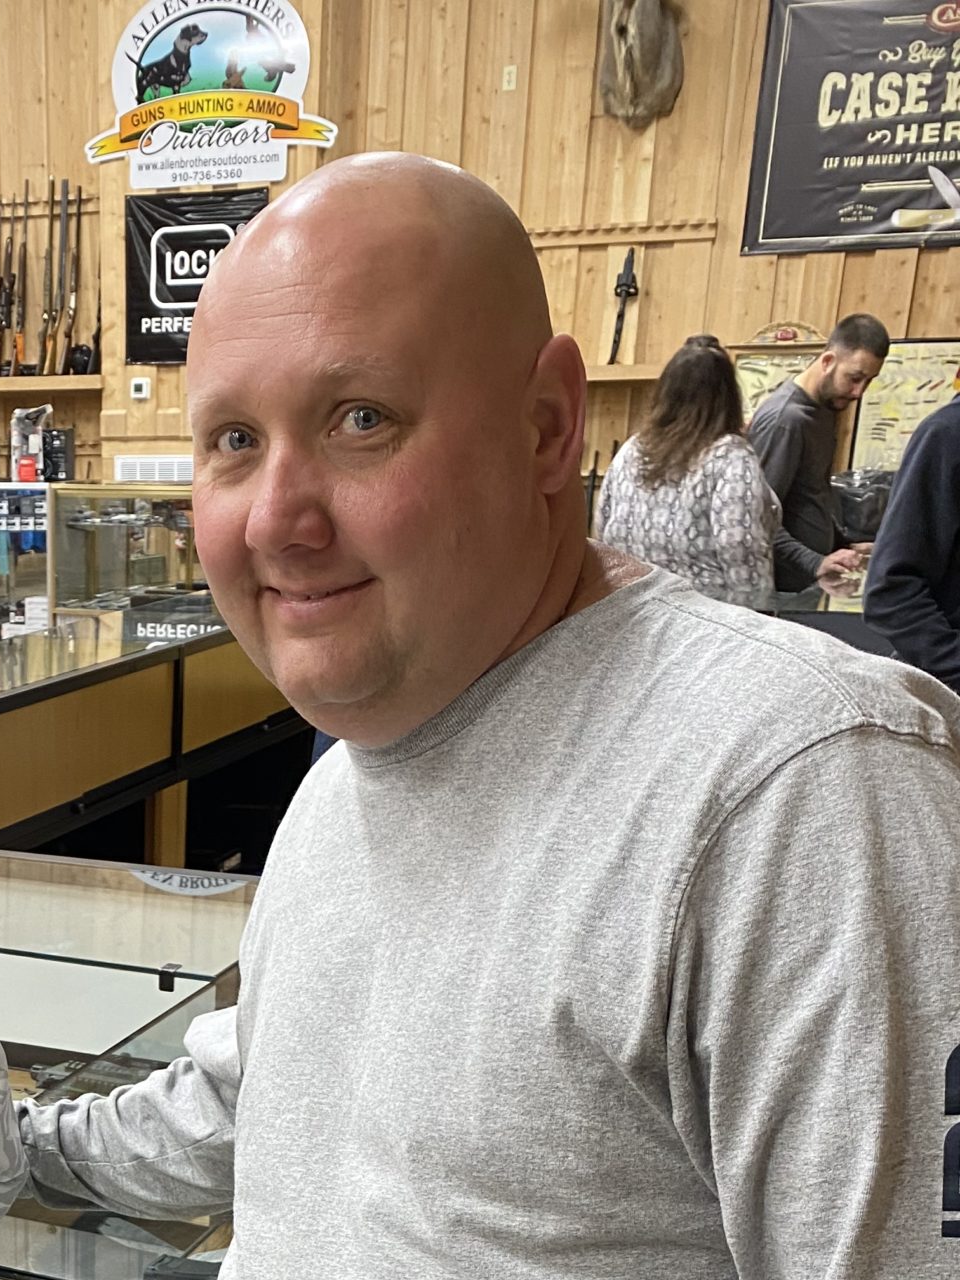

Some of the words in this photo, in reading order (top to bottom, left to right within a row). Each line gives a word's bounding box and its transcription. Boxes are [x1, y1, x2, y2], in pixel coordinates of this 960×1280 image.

[908, 40, 946, 69] Buy
[131, 106, 165, 127] GUNS
[178, 97, 234, 116] HUNTING
[246, 99, 286, 117] AMMO
[818, 71, 933, 128] CASE
[140, 120, 272, 155] Outdoors
[137, 152, 280, 171] www.allenbrothersoutdoors.com
[843, 155, 863, 167] YOU
[867, 152, 912, 166] HAVEN'T
[172, 169, 243, 182] 910-736-5360
